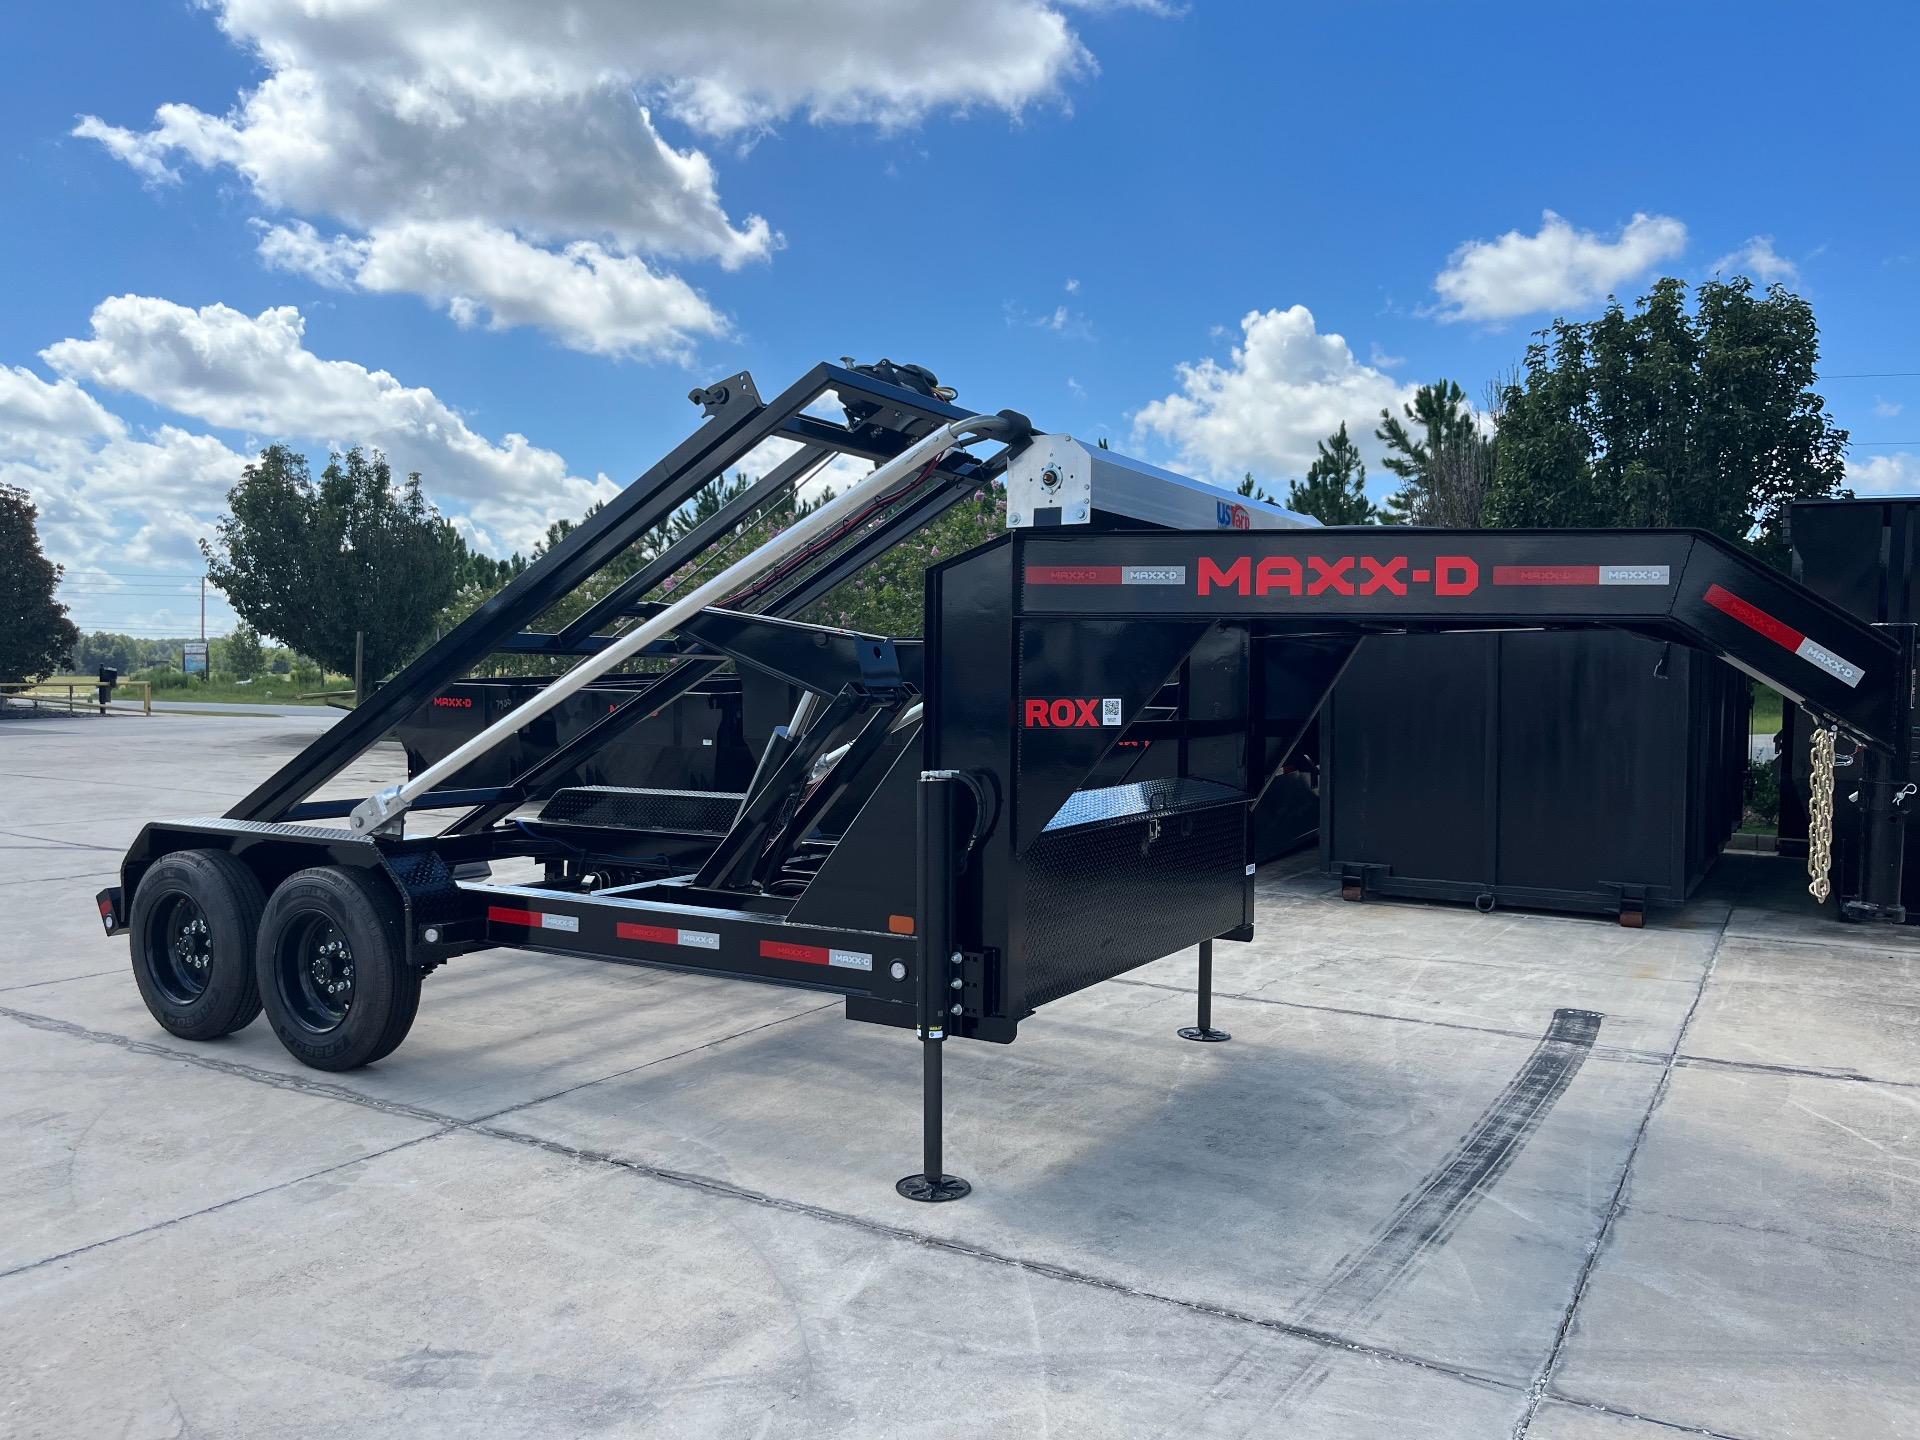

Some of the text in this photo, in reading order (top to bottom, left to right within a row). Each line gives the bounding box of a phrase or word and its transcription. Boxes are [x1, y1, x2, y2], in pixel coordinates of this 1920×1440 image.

[1130, 571, 1177, 580] MAXX-D
[1198, 556, 1479, 596] MAXX-D
[1608, 571, 1661, 580] MAXX-D
[1806, 646, 1855, 678] MAXX-D
[433, 697, 473, 709] MAXX-D
[1025, 698, 1100, 727] ROX
[683, 934, 715, 945] MAXX-D
[835, 954, 871, 966] MAXX-D
